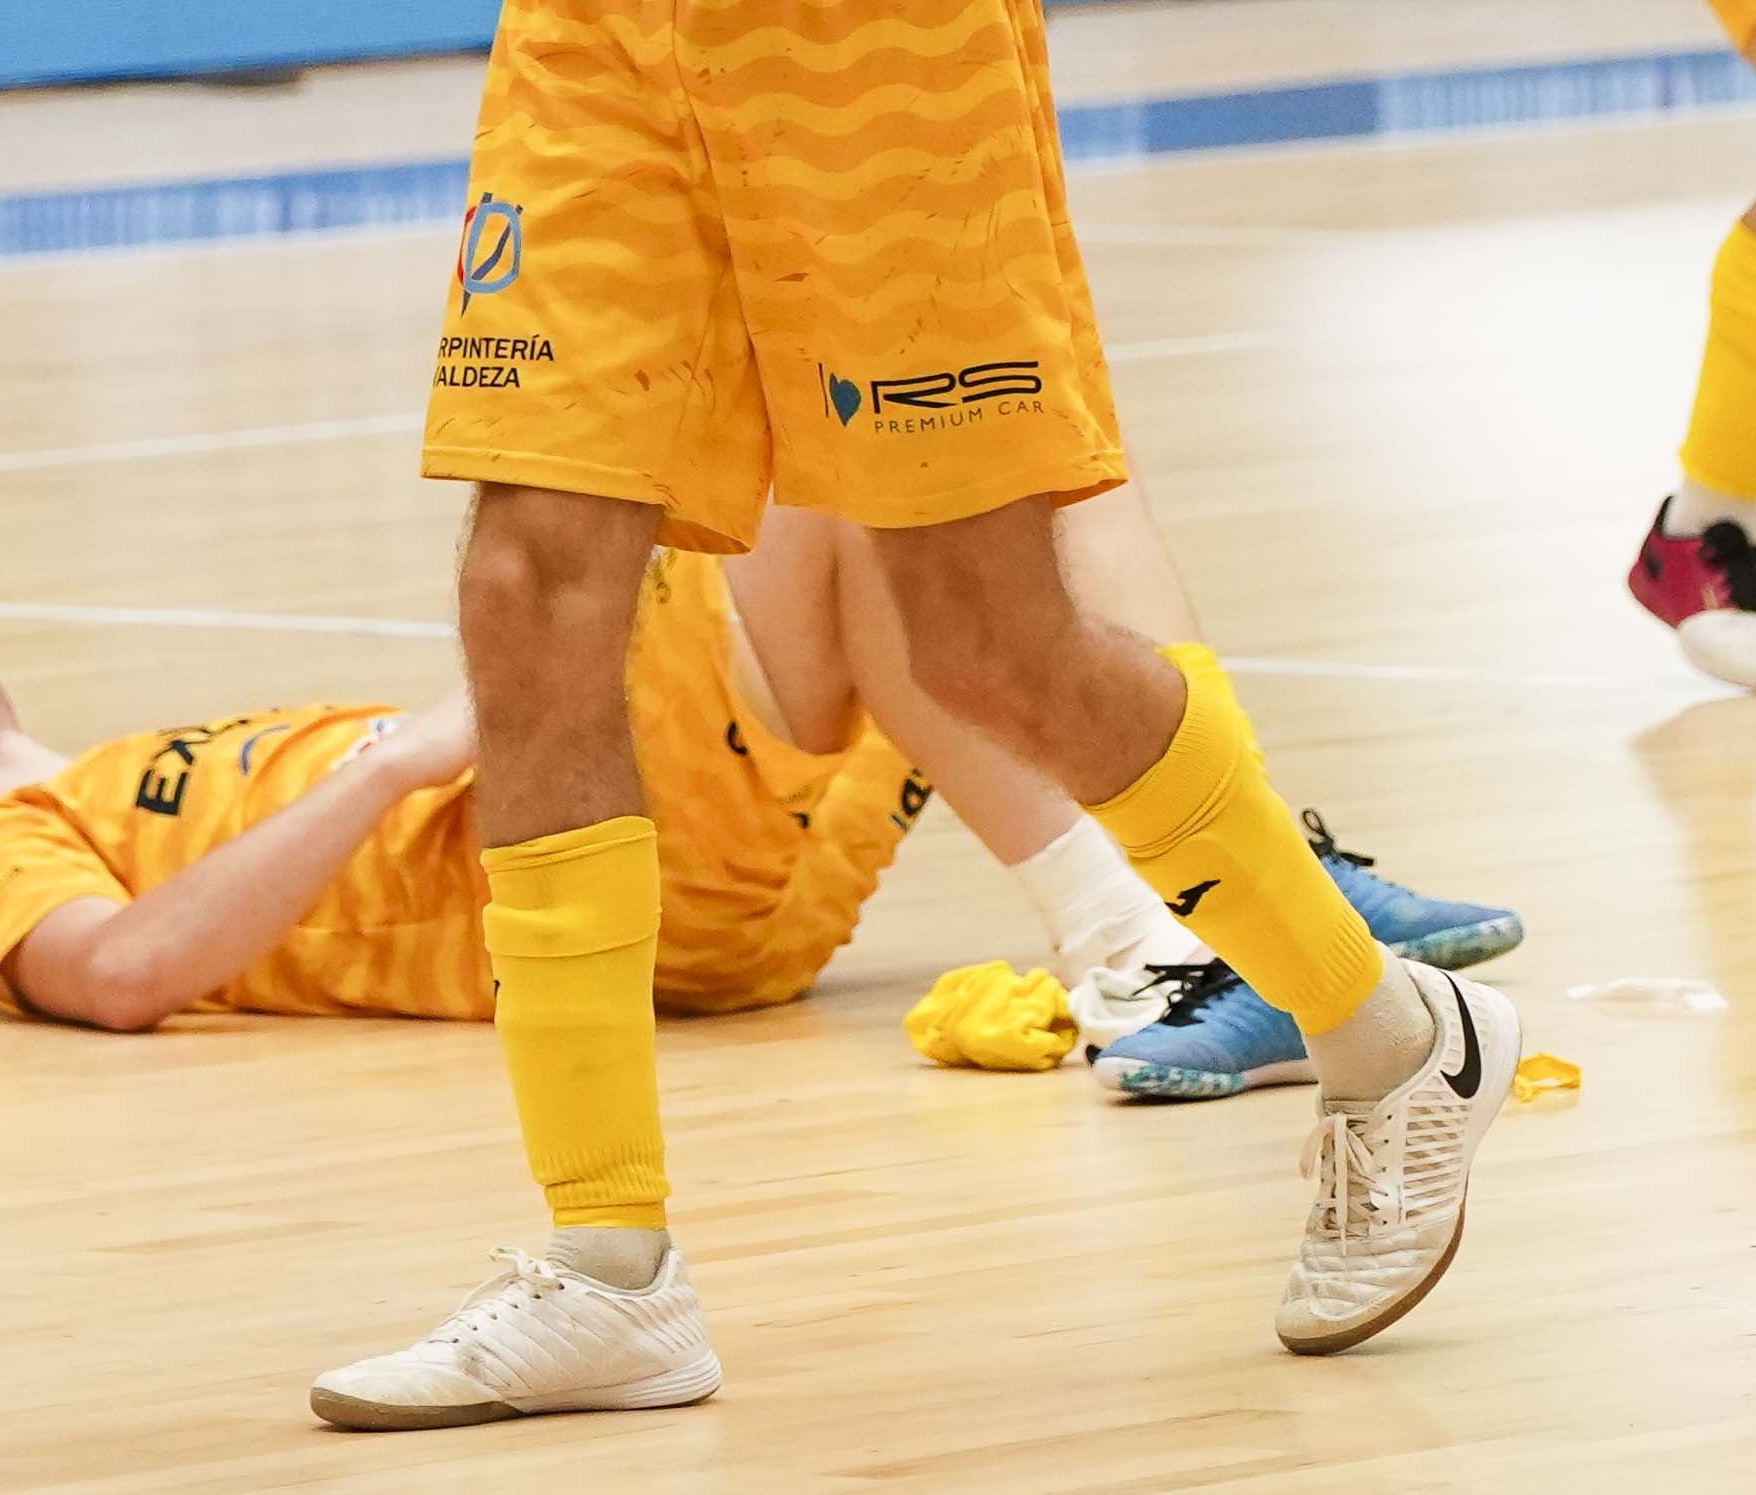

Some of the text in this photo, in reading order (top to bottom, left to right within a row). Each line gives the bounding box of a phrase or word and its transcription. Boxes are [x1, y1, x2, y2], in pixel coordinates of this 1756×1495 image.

[433, 365, 521, 388] ALDEZA
[870, 361, 1042, 414] RS
[873, 399, 1045, 434] PREMIUM CAR
